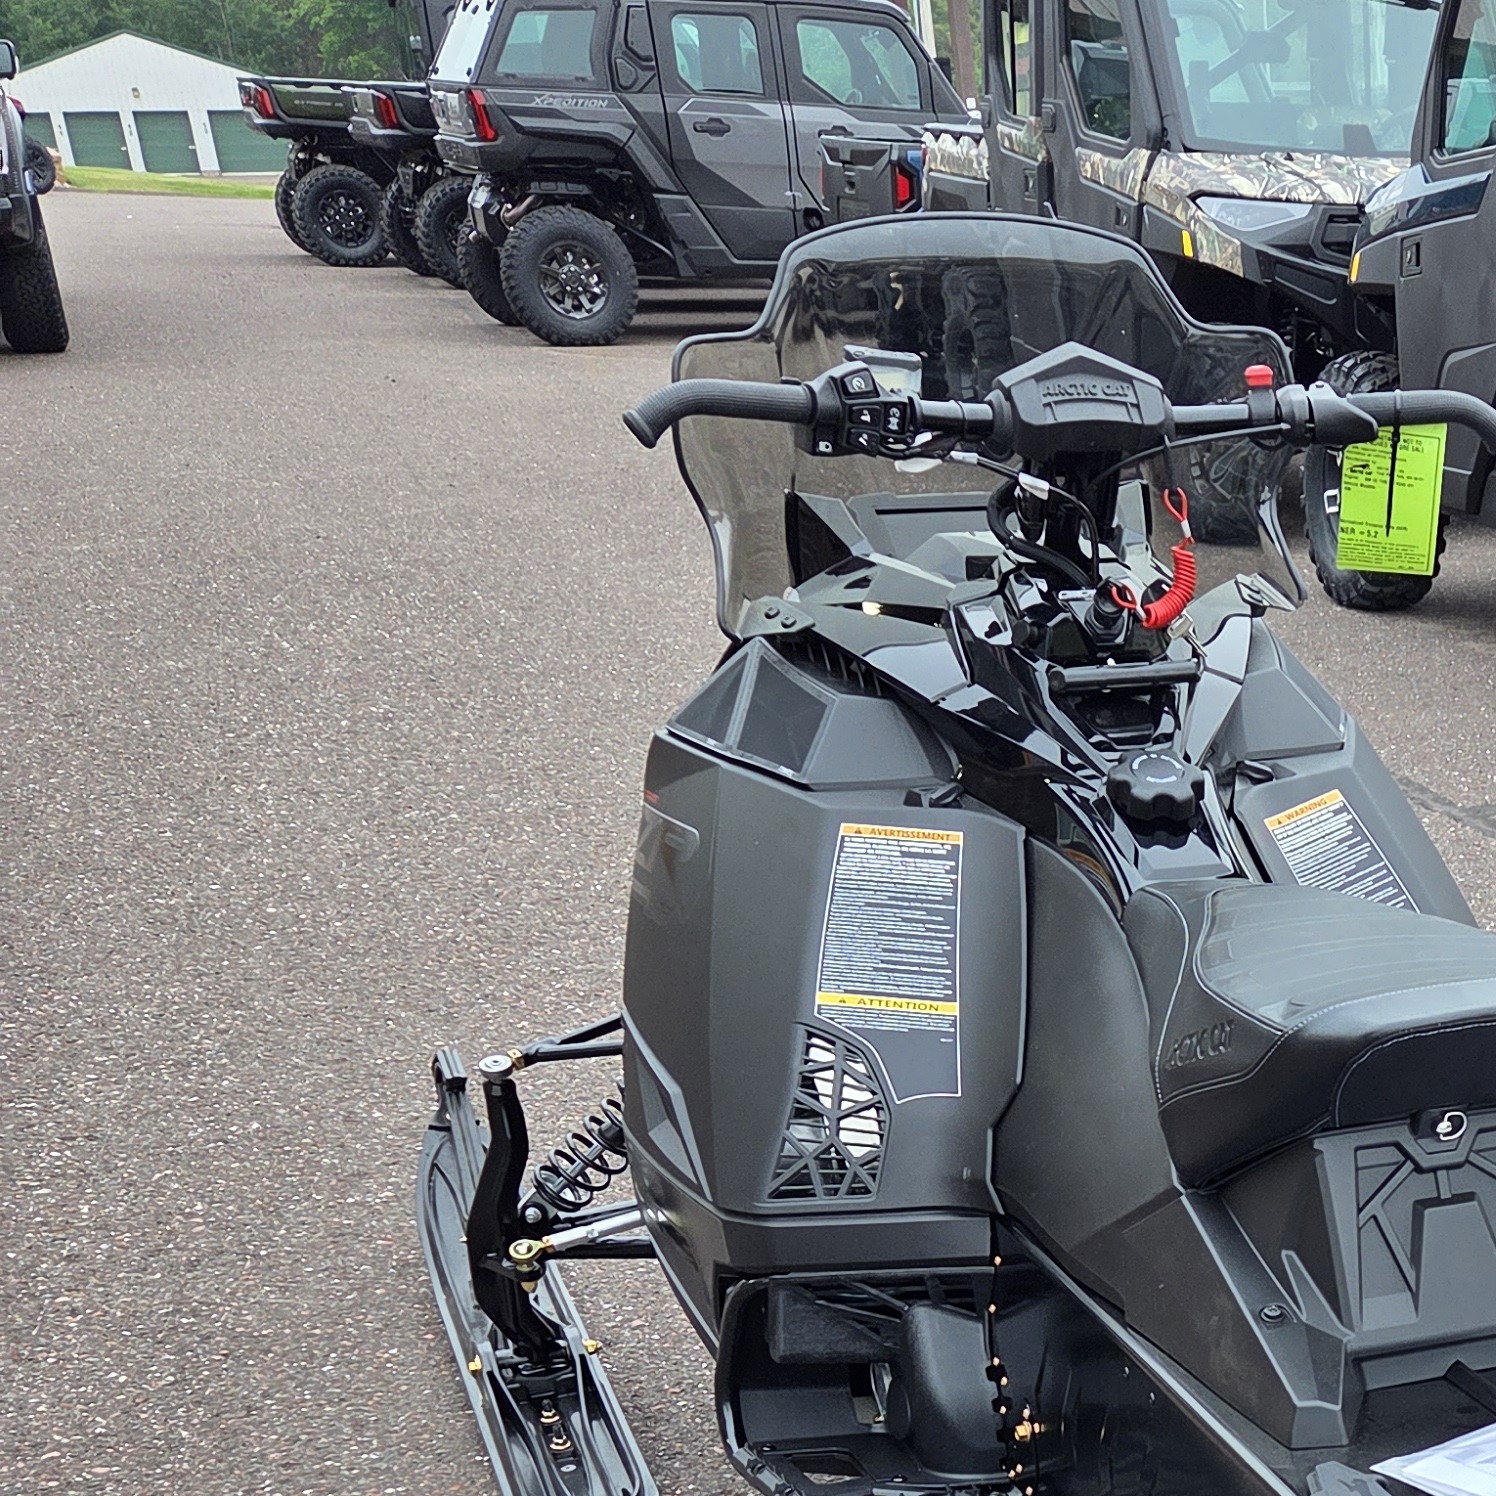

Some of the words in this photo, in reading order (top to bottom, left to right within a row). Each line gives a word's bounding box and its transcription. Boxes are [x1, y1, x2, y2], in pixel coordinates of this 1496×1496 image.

[531, 94, 609, 108] XPEDITION
[1042, 383, 1098, 398] ARCTIC
[1102, 383, 1131, 398] CAT
[1284, 797, 1328, 821] WARNING
[869, 827, 951, 841] AVERTISSEMENT
[857, 998, 940, 1012] ATTENTION
